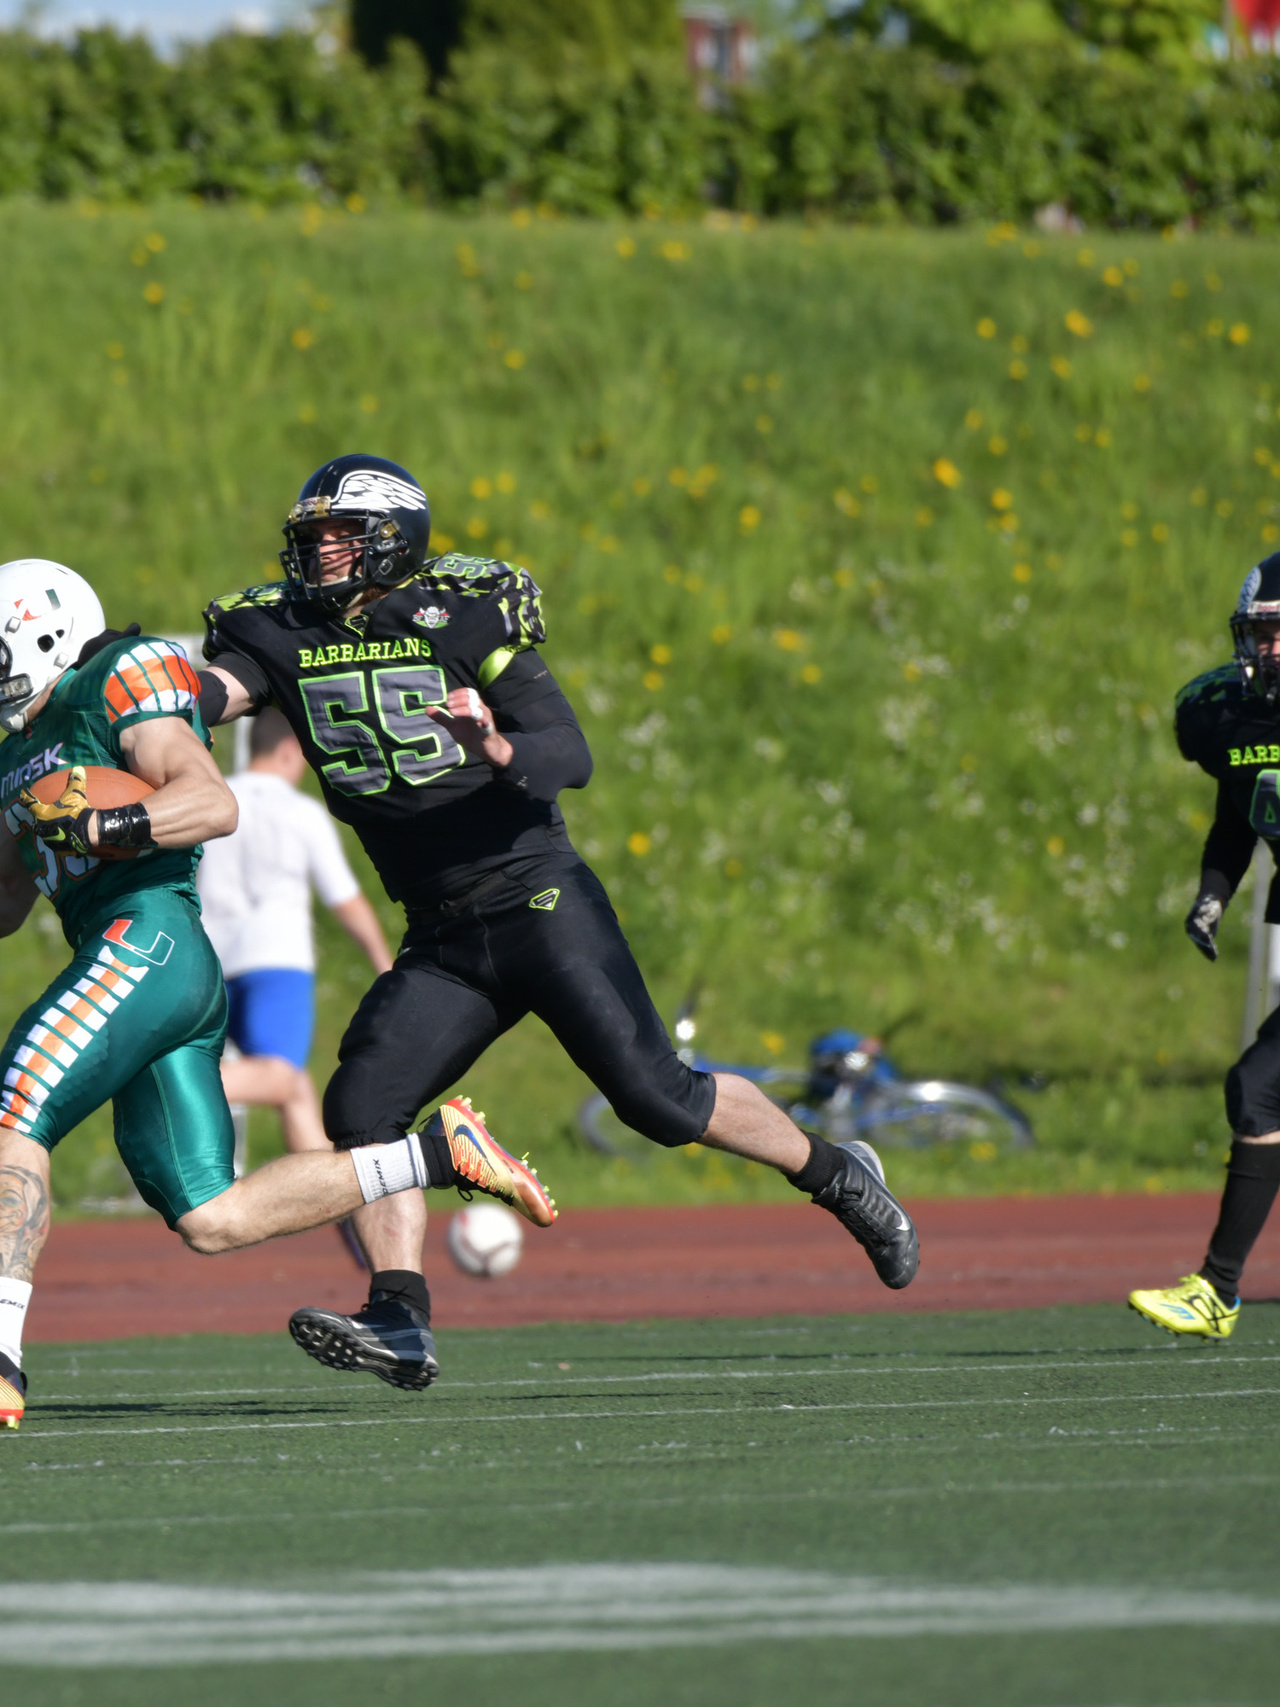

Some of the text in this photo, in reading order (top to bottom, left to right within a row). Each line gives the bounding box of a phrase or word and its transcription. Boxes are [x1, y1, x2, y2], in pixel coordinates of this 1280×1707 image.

[298, 638, 432, 668] BARBARIANS
[298, 665, 466, 797] 55
[373, 1158, 389, 1196] DEMIX
